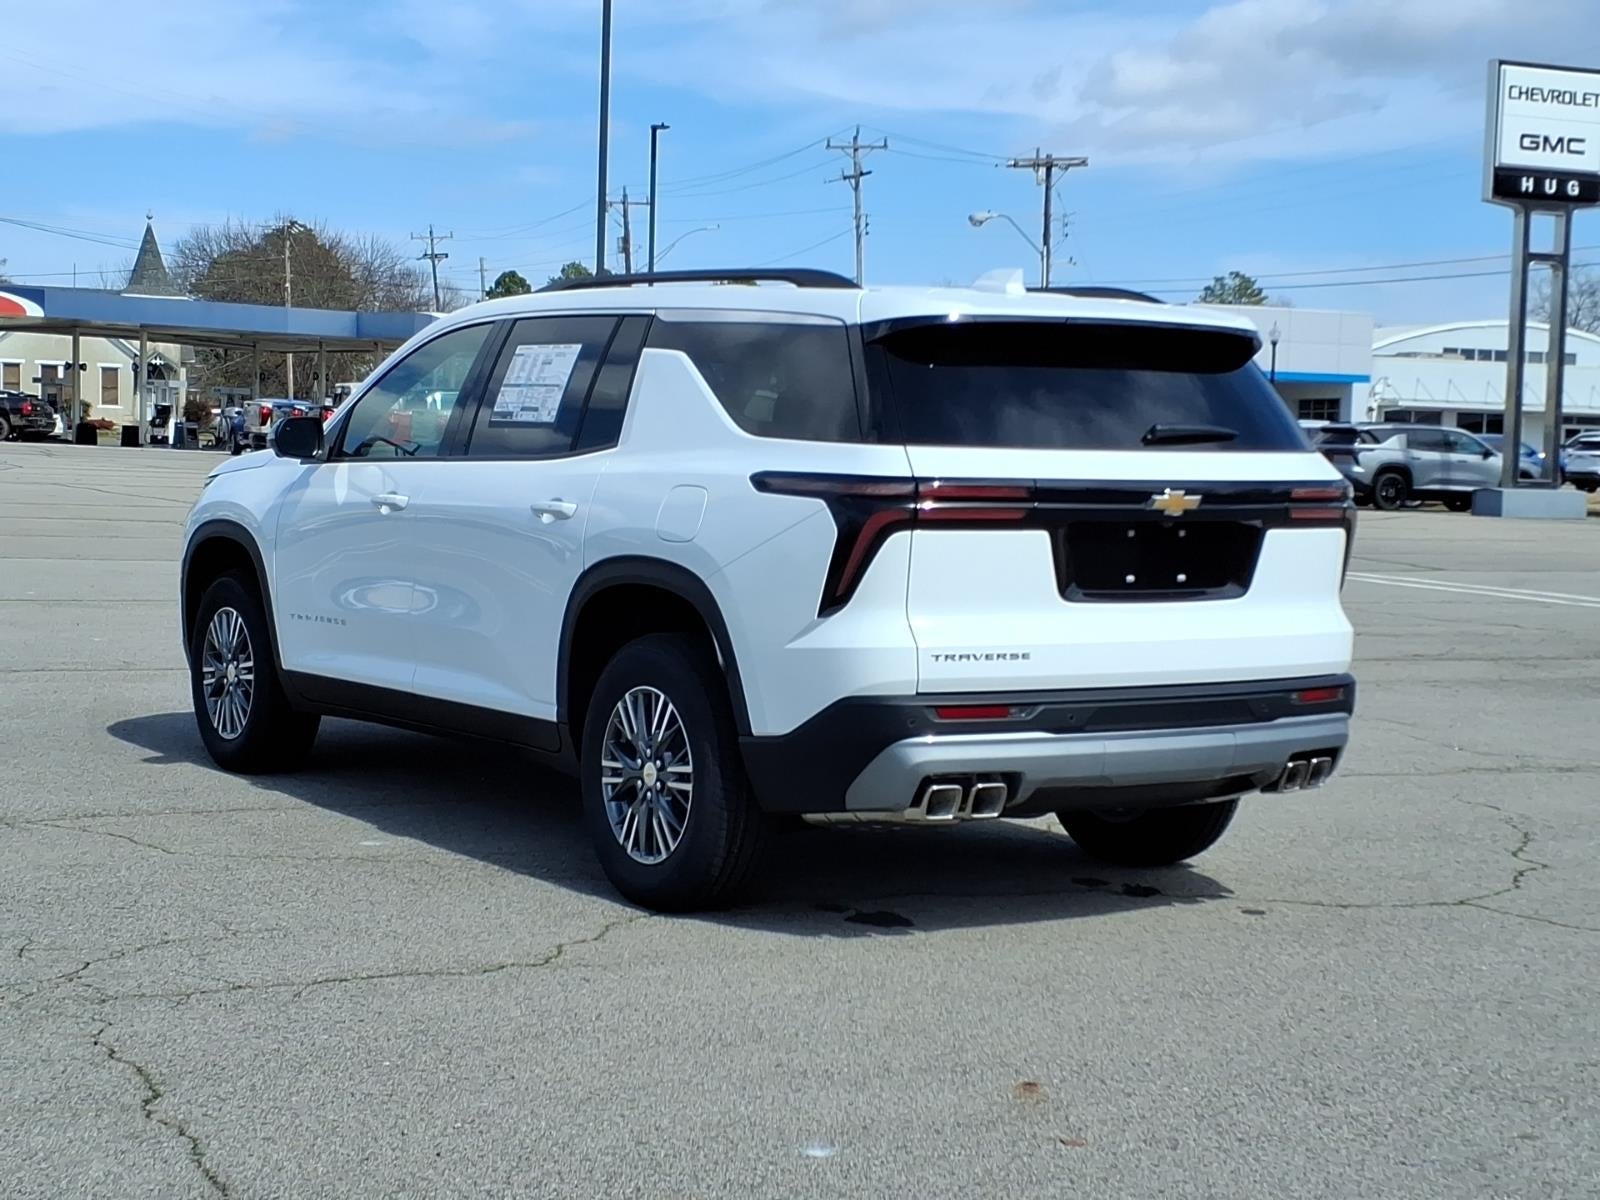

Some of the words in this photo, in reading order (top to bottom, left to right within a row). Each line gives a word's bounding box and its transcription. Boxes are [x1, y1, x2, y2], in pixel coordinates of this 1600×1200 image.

[1508, 84, 1600, 108] CHEVROLET
[1520, 133, 1586, 155] GMC
[1521, 176, 1580, 196] HUG
[931, 652, 1031, 662] TRAVERSE
